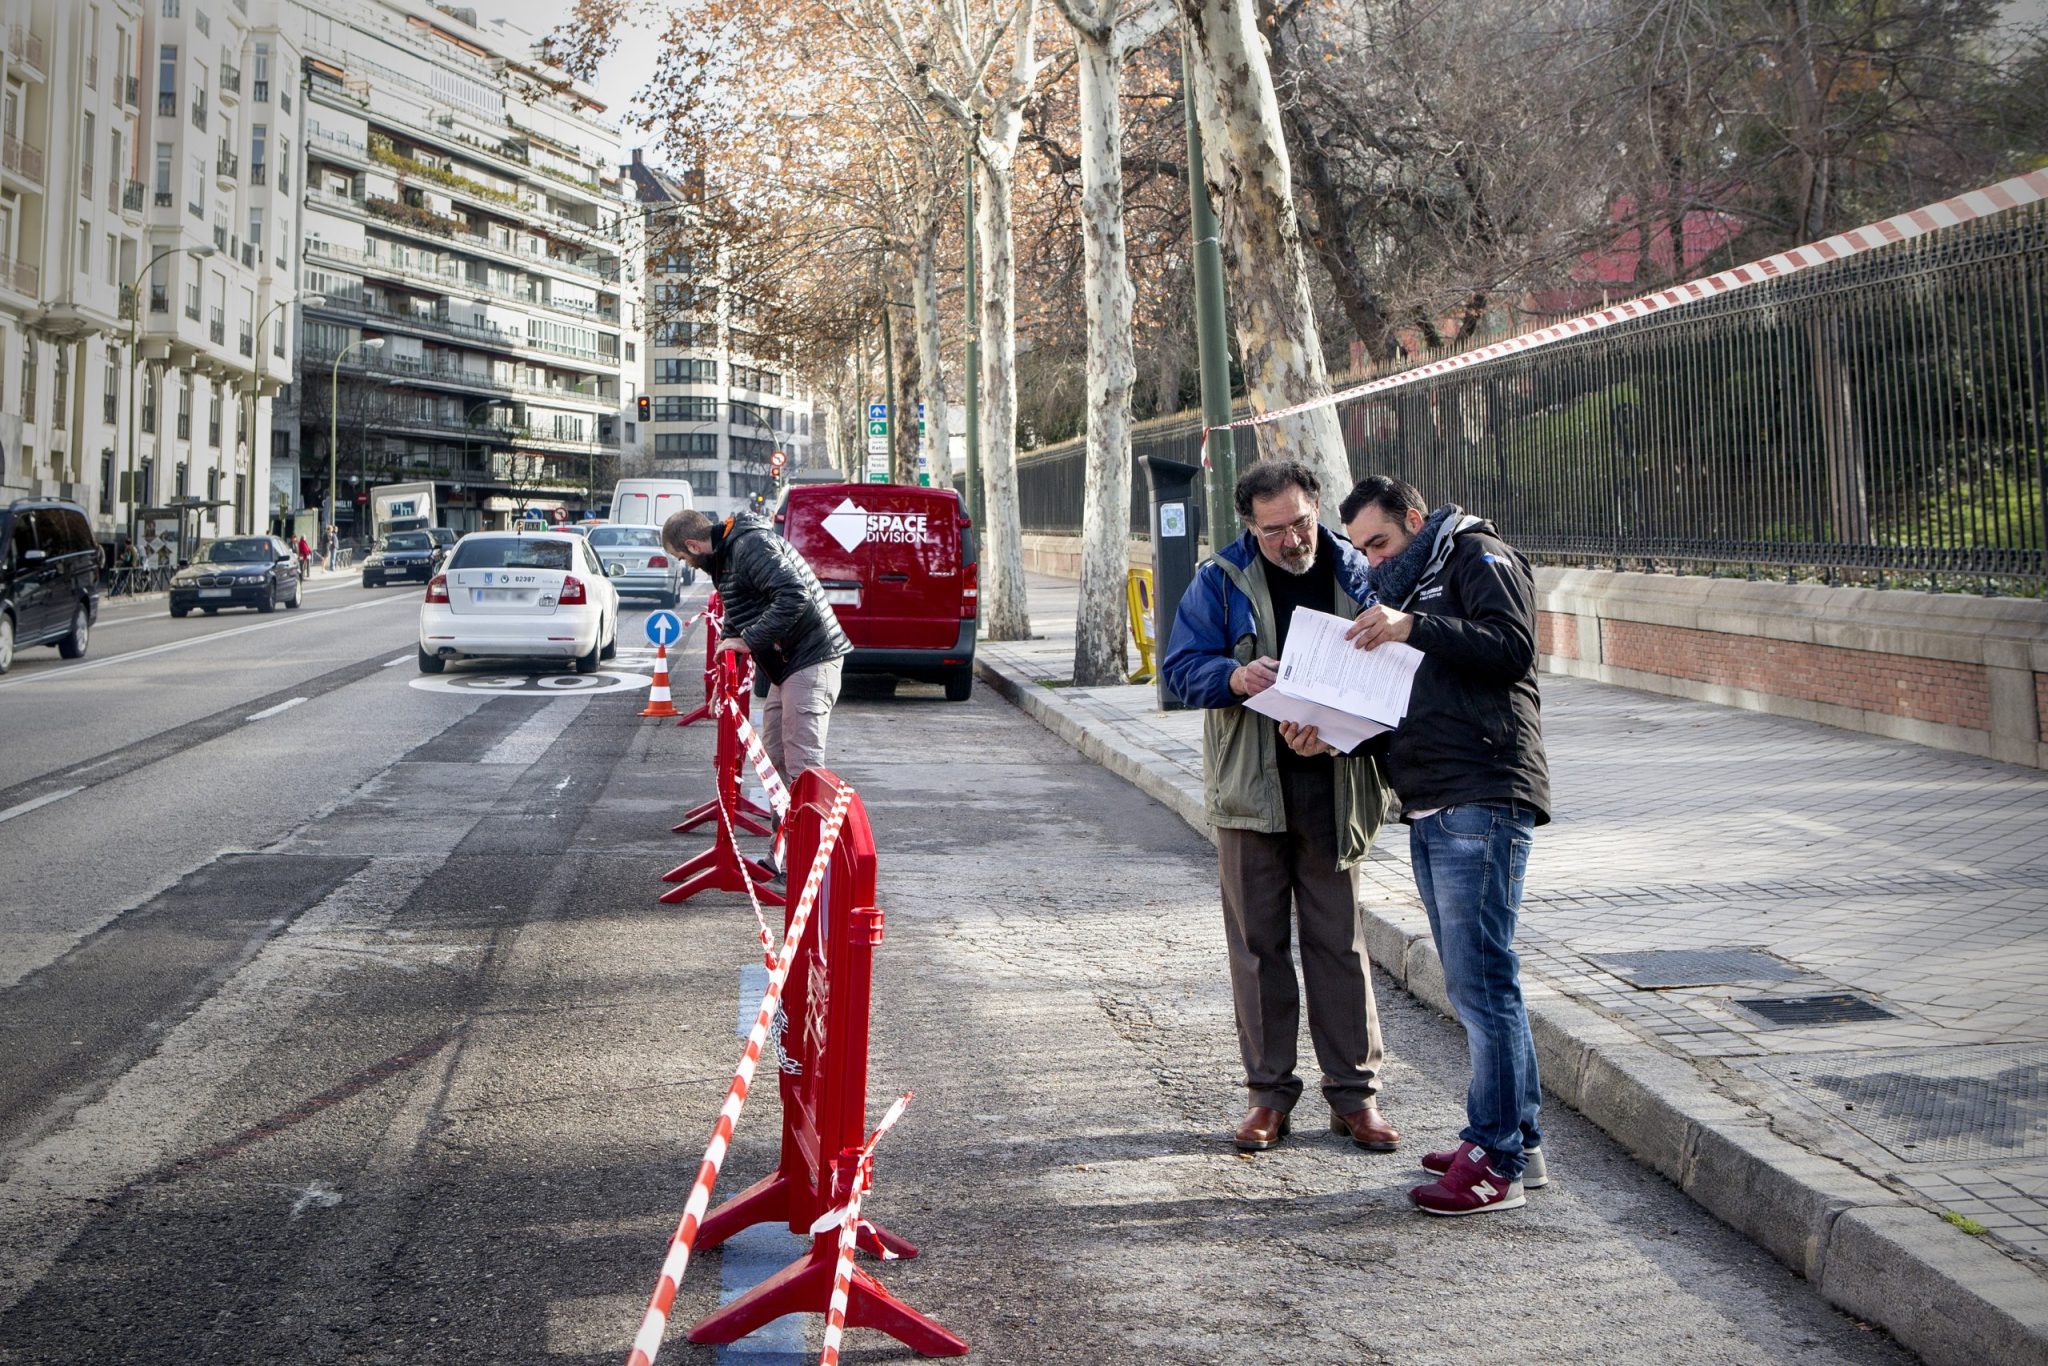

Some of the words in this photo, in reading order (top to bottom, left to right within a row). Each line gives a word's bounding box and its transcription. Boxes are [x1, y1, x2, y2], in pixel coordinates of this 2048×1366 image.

[525, 522, 540, 530] TAXI
[867, 516, 927, 532] SPACE
[866, 532, 927, 543] DIVISION
[467, 674, 599, 689] 30
[1471, 1180, 1499, 1203] N
